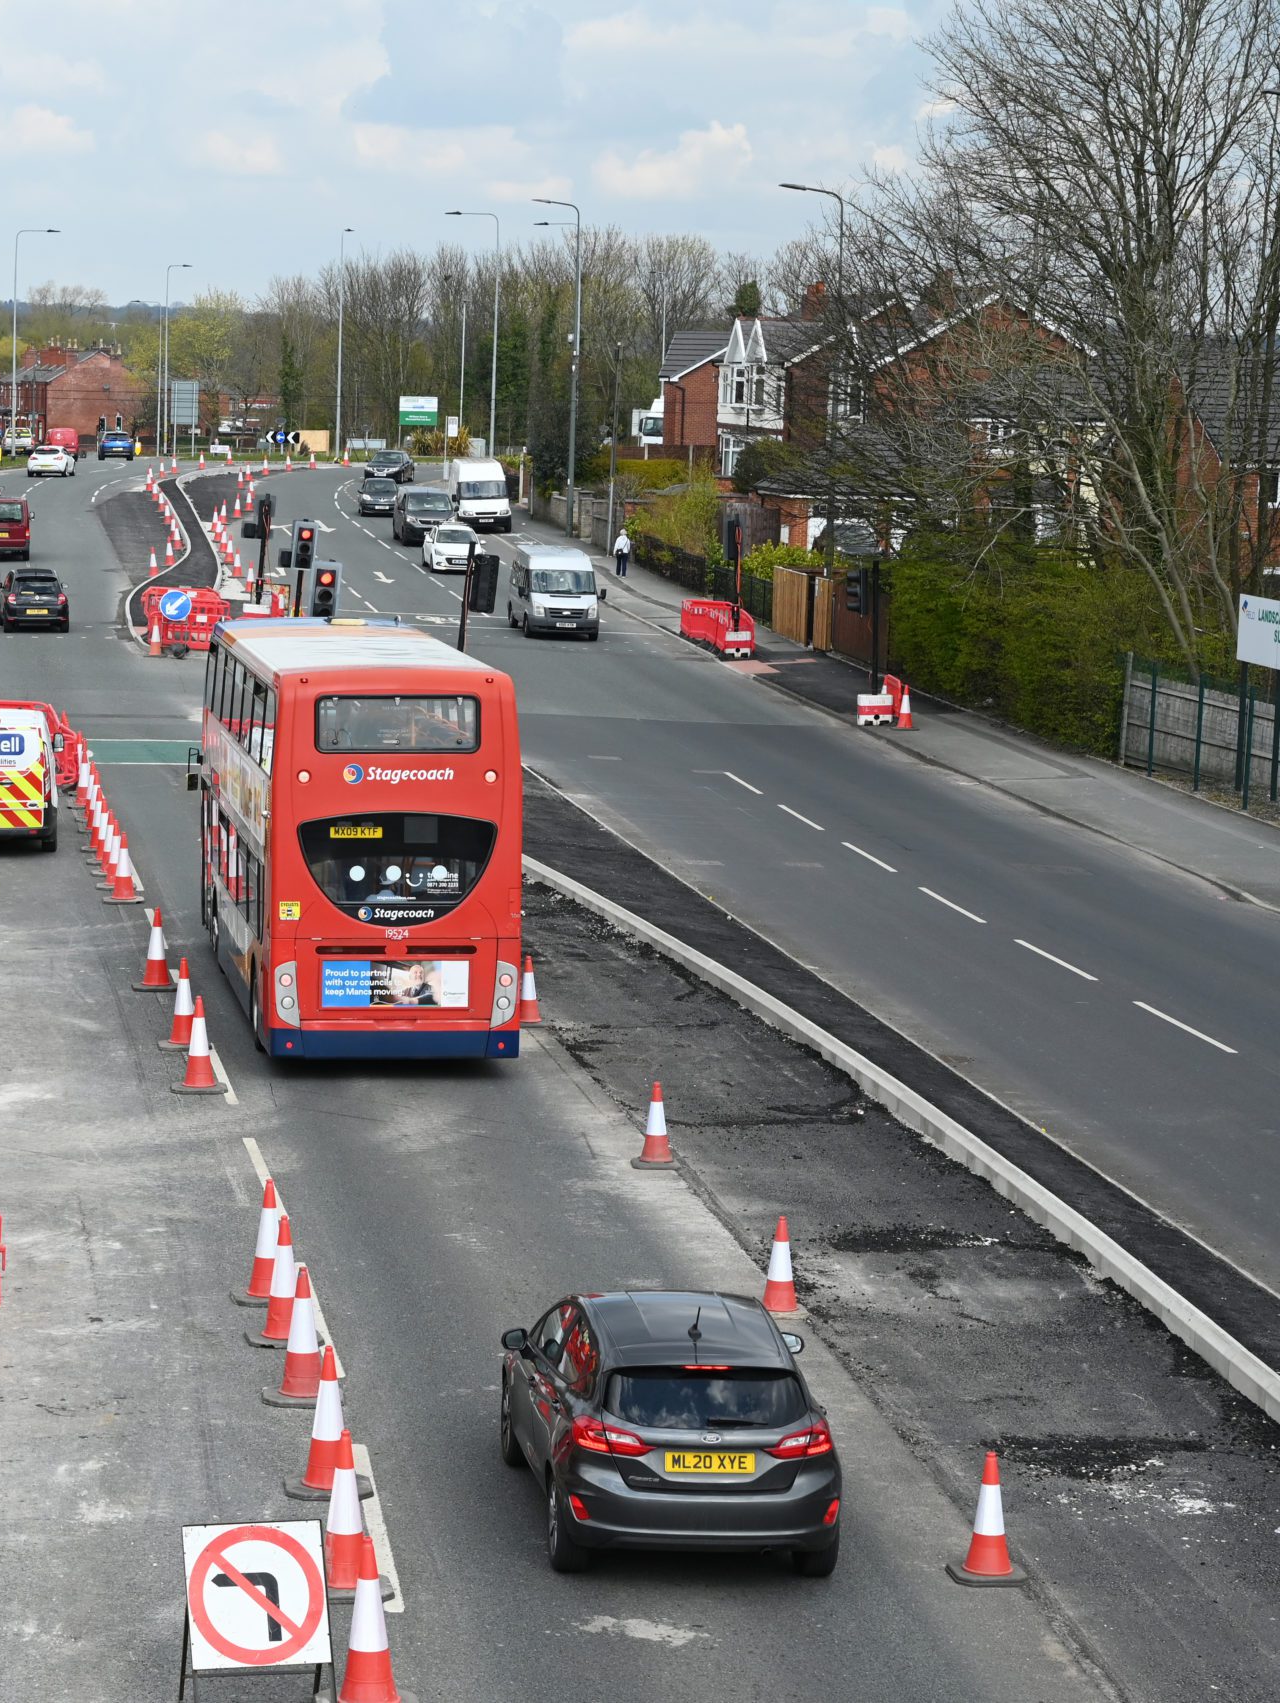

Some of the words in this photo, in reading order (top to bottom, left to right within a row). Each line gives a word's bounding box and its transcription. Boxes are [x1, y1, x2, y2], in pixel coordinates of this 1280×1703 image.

[1258, 608, 1280, 625] LANDSC
[366, 766, 454, 784] Stagecoach
[333, 827, 358, 836] MX09
[360, 827, 379, 836] KTF
[373, 908, 434, 920] Stagecoach
[385, 929, 409, 939] 19524
[325, 968, 349, 977] Proud
[351, 969, 359, 977] to
[360, 969, 390, 979] partner
[325, 978, 343, 986] with
[359, 978, 393, 986] councils
[325, 988, 345, 997] keep
[346, 988, 372, 996] Mancs
[671, 1454, 713, 1469] ML20
[717, 1455, 748, 1470] XYE
